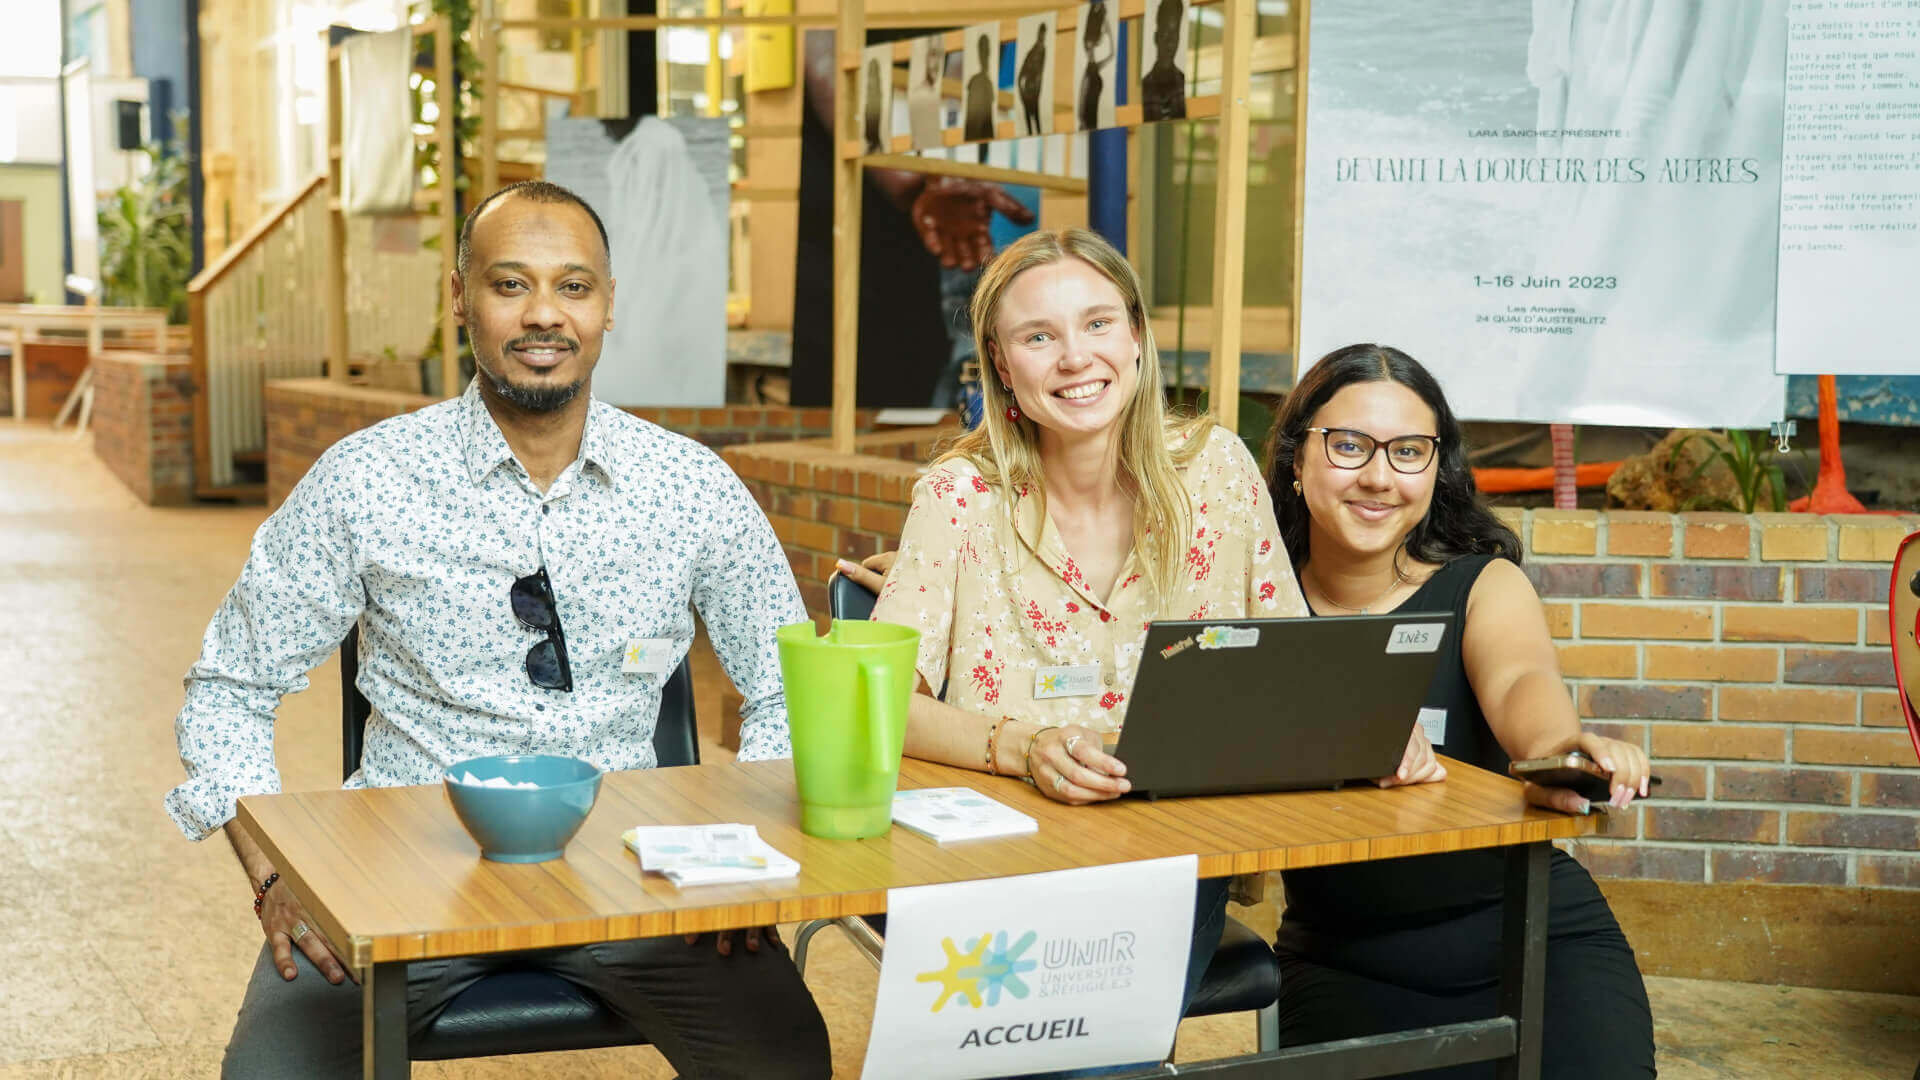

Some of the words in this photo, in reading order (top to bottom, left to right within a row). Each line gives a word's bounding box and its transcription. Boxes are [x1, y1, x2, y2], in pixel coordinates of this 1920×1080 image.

[1468, 129, 1499, 138] LARA
[1502, 129, 1558, 138] SANCHEZ
[1560, 128, 1621, 138] PRÉSENTE
[1336, 157, 1433, 182] DEVANT
[1438, 157, 1467, 182] LA
[1476, 157, 1586, 183] DOUCEUR
[1595, 158, 1646, 183] DES
[1659, 158, 1759, 184] AUTRES
[1521, 275, 1560, 288] Juin
[1568, 276, 1617, 289] 2023
[1507, 305, 1526, 313] Les
[1530, 305, 1576, 313] Amarres
[1475, 315, 1489, 323] 24
[1493, 315, 1521, 323] QUAI
[1524, 315, 1606, 325] D'AUSTERLITZ
[1040, 985, 1048, 998] &
[959, 1017, 1089, 1049] ACCUEIL
